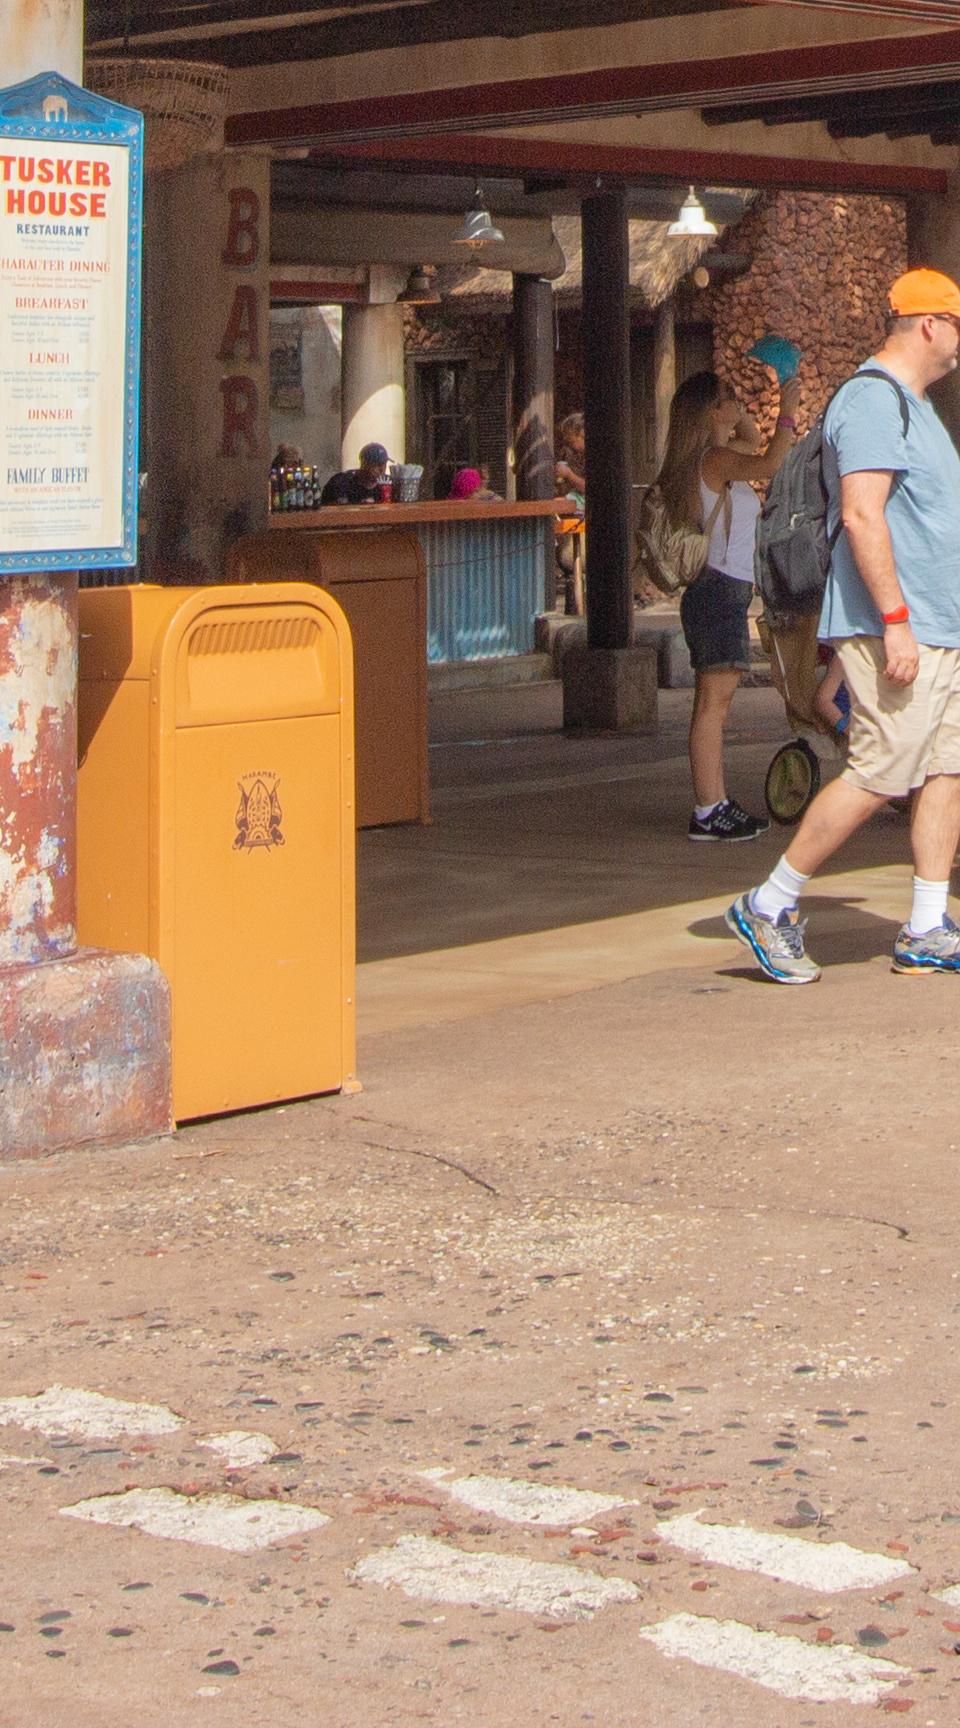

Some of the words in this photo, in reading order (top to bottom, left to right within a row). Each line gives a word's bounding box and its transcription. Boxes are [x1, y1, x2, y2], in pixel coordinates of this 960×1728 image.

[0, 155, 111, 187] TUSKER
[7, 189, 106, 217] HOUSE
[16, 223, 90, 236] RESTAURANT
[0, 257, 64, 271] HARACTER
[70, 260, 110, 273] DINING
[15, 297, 88, 309] BREAKFAST
[216, 187, 269, 458] BAR
[29, 352, 70, 364] LUNCH
[28, 409, 73, 420] DINNER
[7, 467, 47, 484] FAMILY
[52, 467, 89, 483] BUFFET
